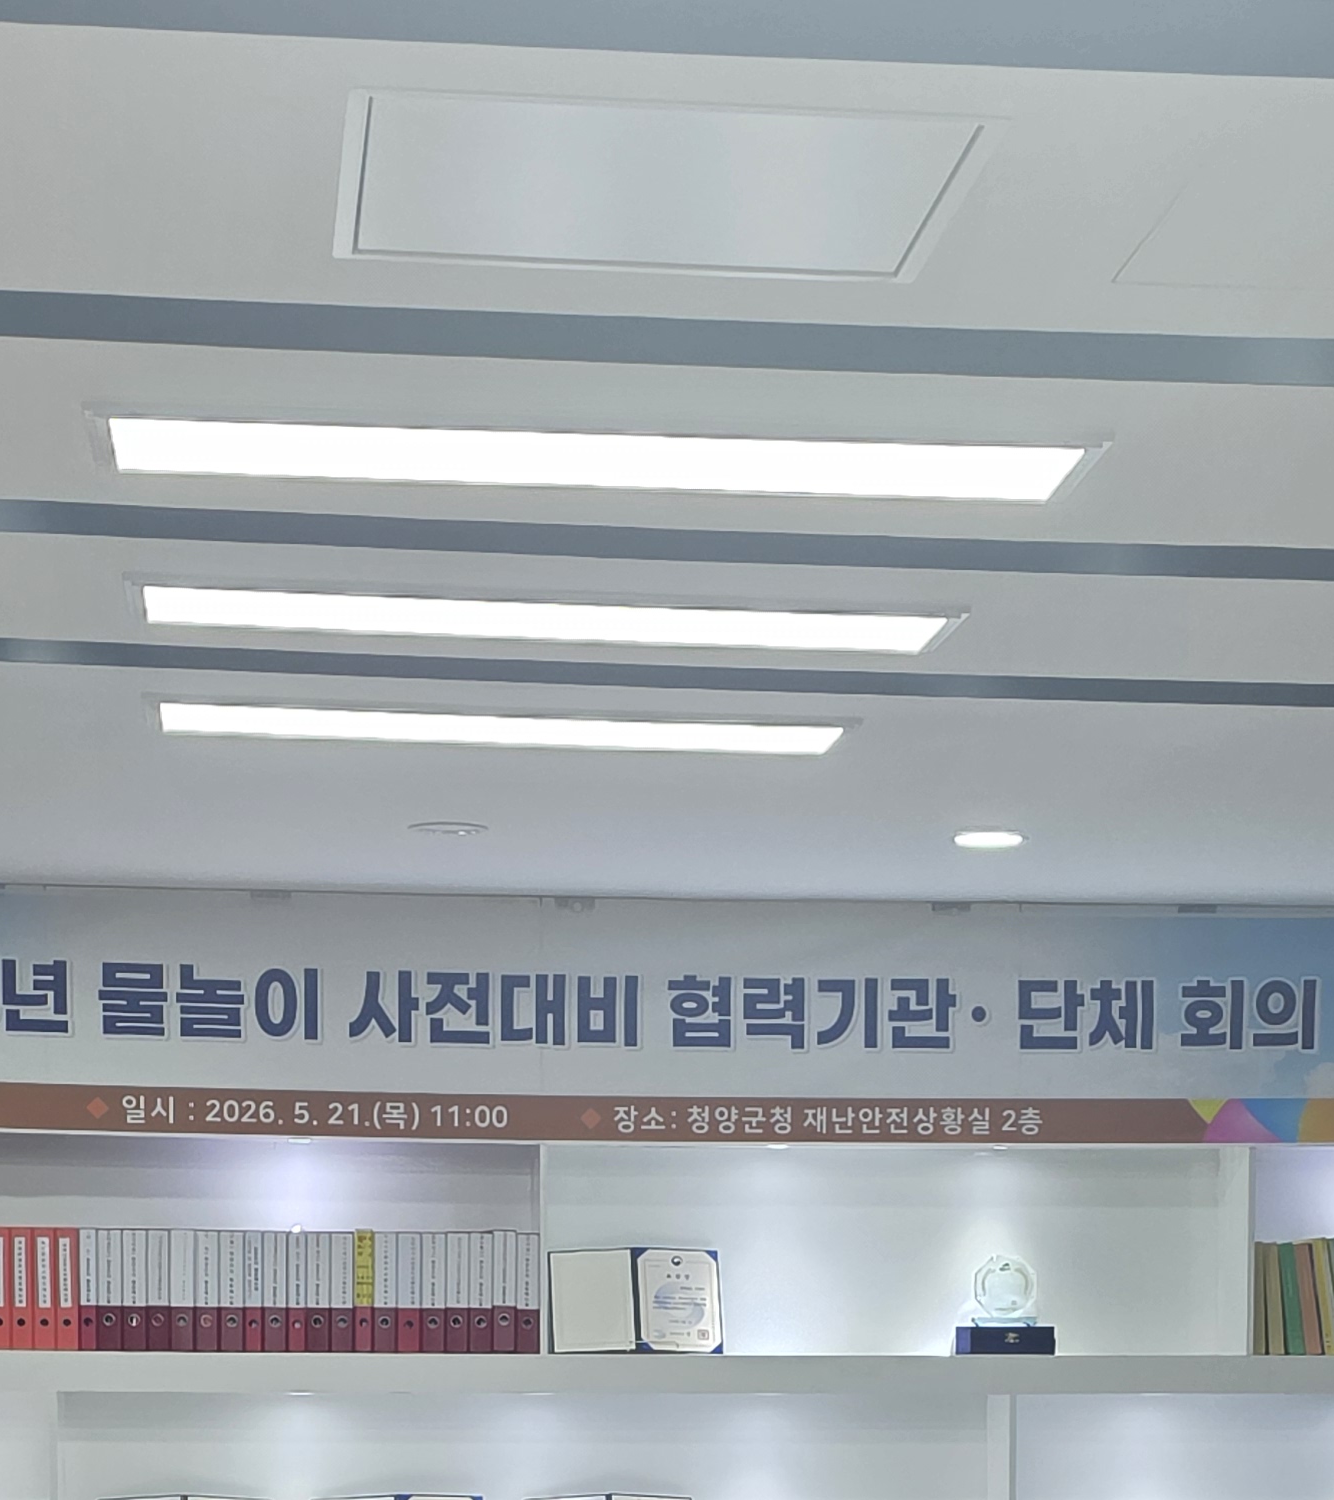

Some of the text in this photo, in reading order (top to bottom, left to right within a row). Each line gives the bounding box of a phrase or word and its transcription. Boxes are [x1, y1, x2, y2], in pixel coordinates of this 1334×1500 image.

[97, 961, 319, 1041] 물놀이
[348, 969, 639, 1048] 사전대비
[1017, 979, 1155, 1051] 단체
[1180, 978, 1318, 1051] 회의
[121, 1095, 175, 1124] 일시
[204, 1099, 284, 1125] 2026.
[293, 1101, 319, 1126] 5.
[327, 1101, 420, 1130] 21.(목)
[430, 1104, 509, 1128] 11:00
[686, 1105, 793, 1134] 청양군청
[802, 1106, 991, 1135] 재난안전상황실
[1000, 1107, 1044, 1135] 2층
